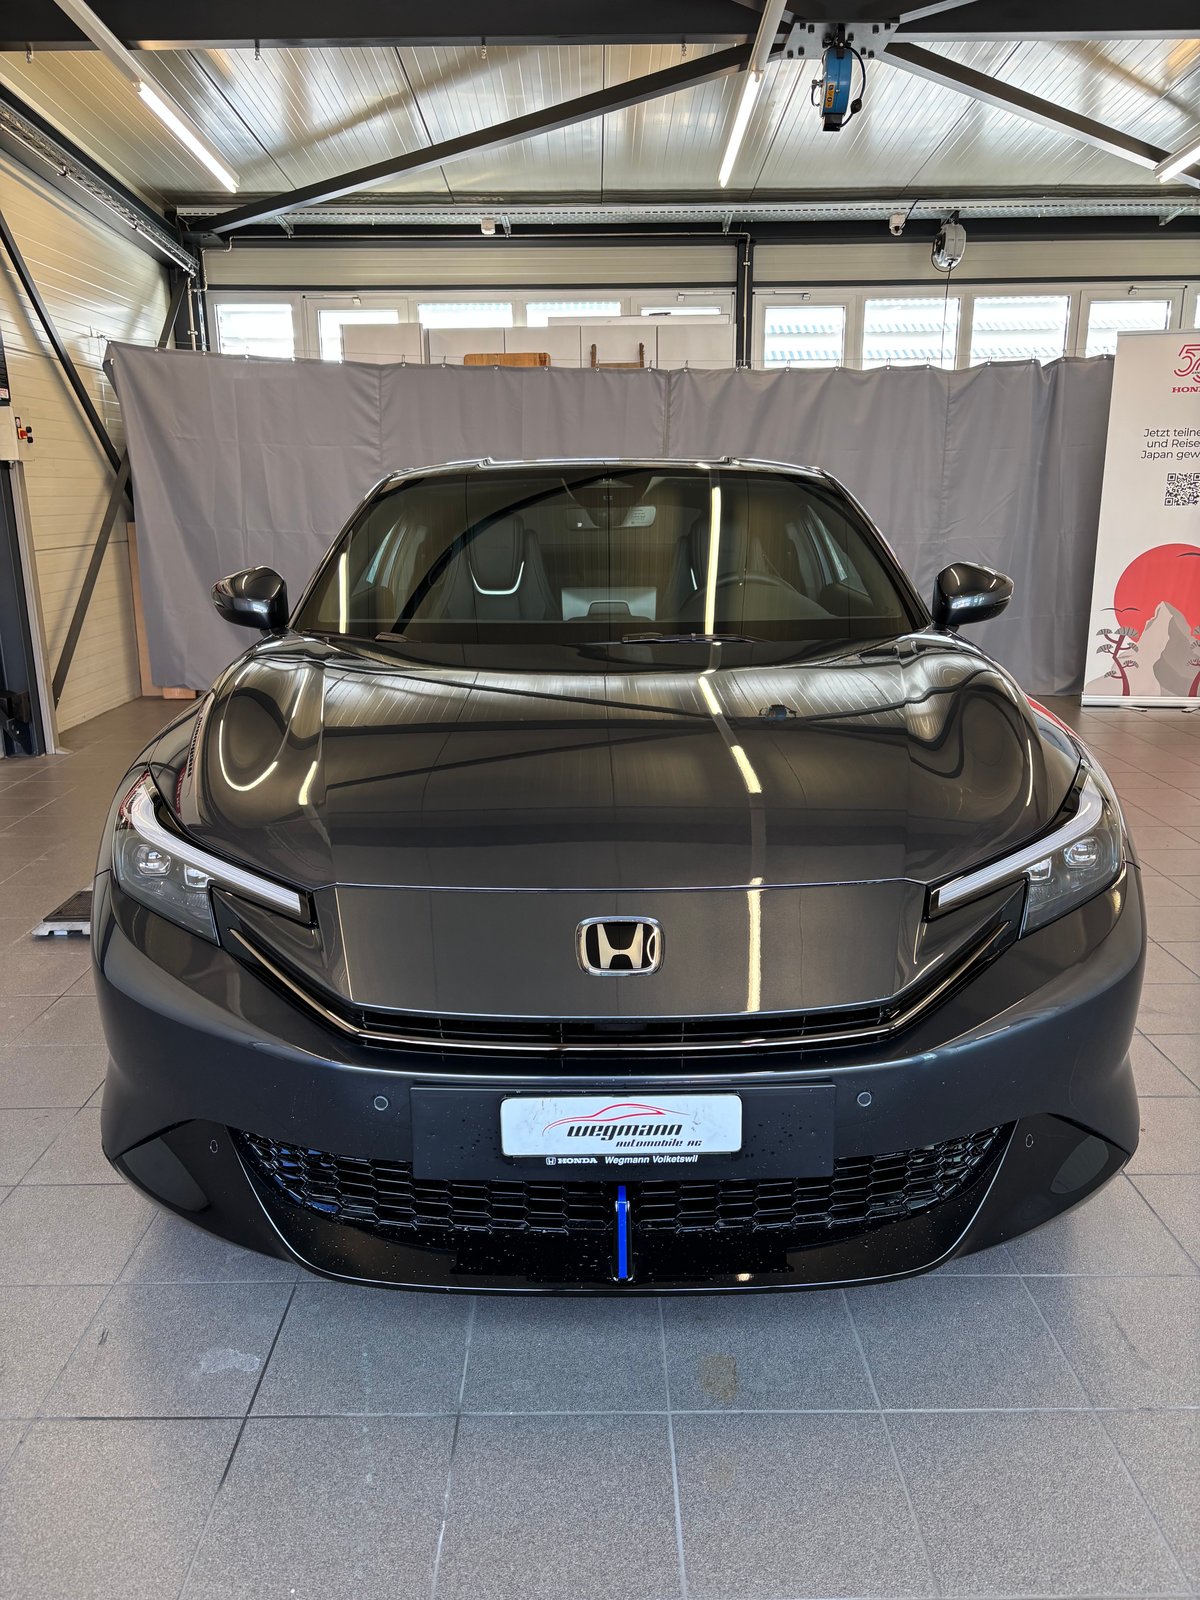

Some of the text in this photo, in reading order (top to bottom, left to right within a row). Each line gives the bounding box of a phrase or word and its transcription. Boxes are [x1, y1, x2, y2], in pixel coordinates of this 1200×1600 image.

[1143, 428, 1170, 437] Jetzt
[1147, 438, 1200, 448] und Reise
[1141, 450, 1173, 461] Japan
[567, 1124, 683, 1141] wegmann
[605, 1156, 649, 1166] Wegmann
[652, 1155, 698, 1164] Volketswil
